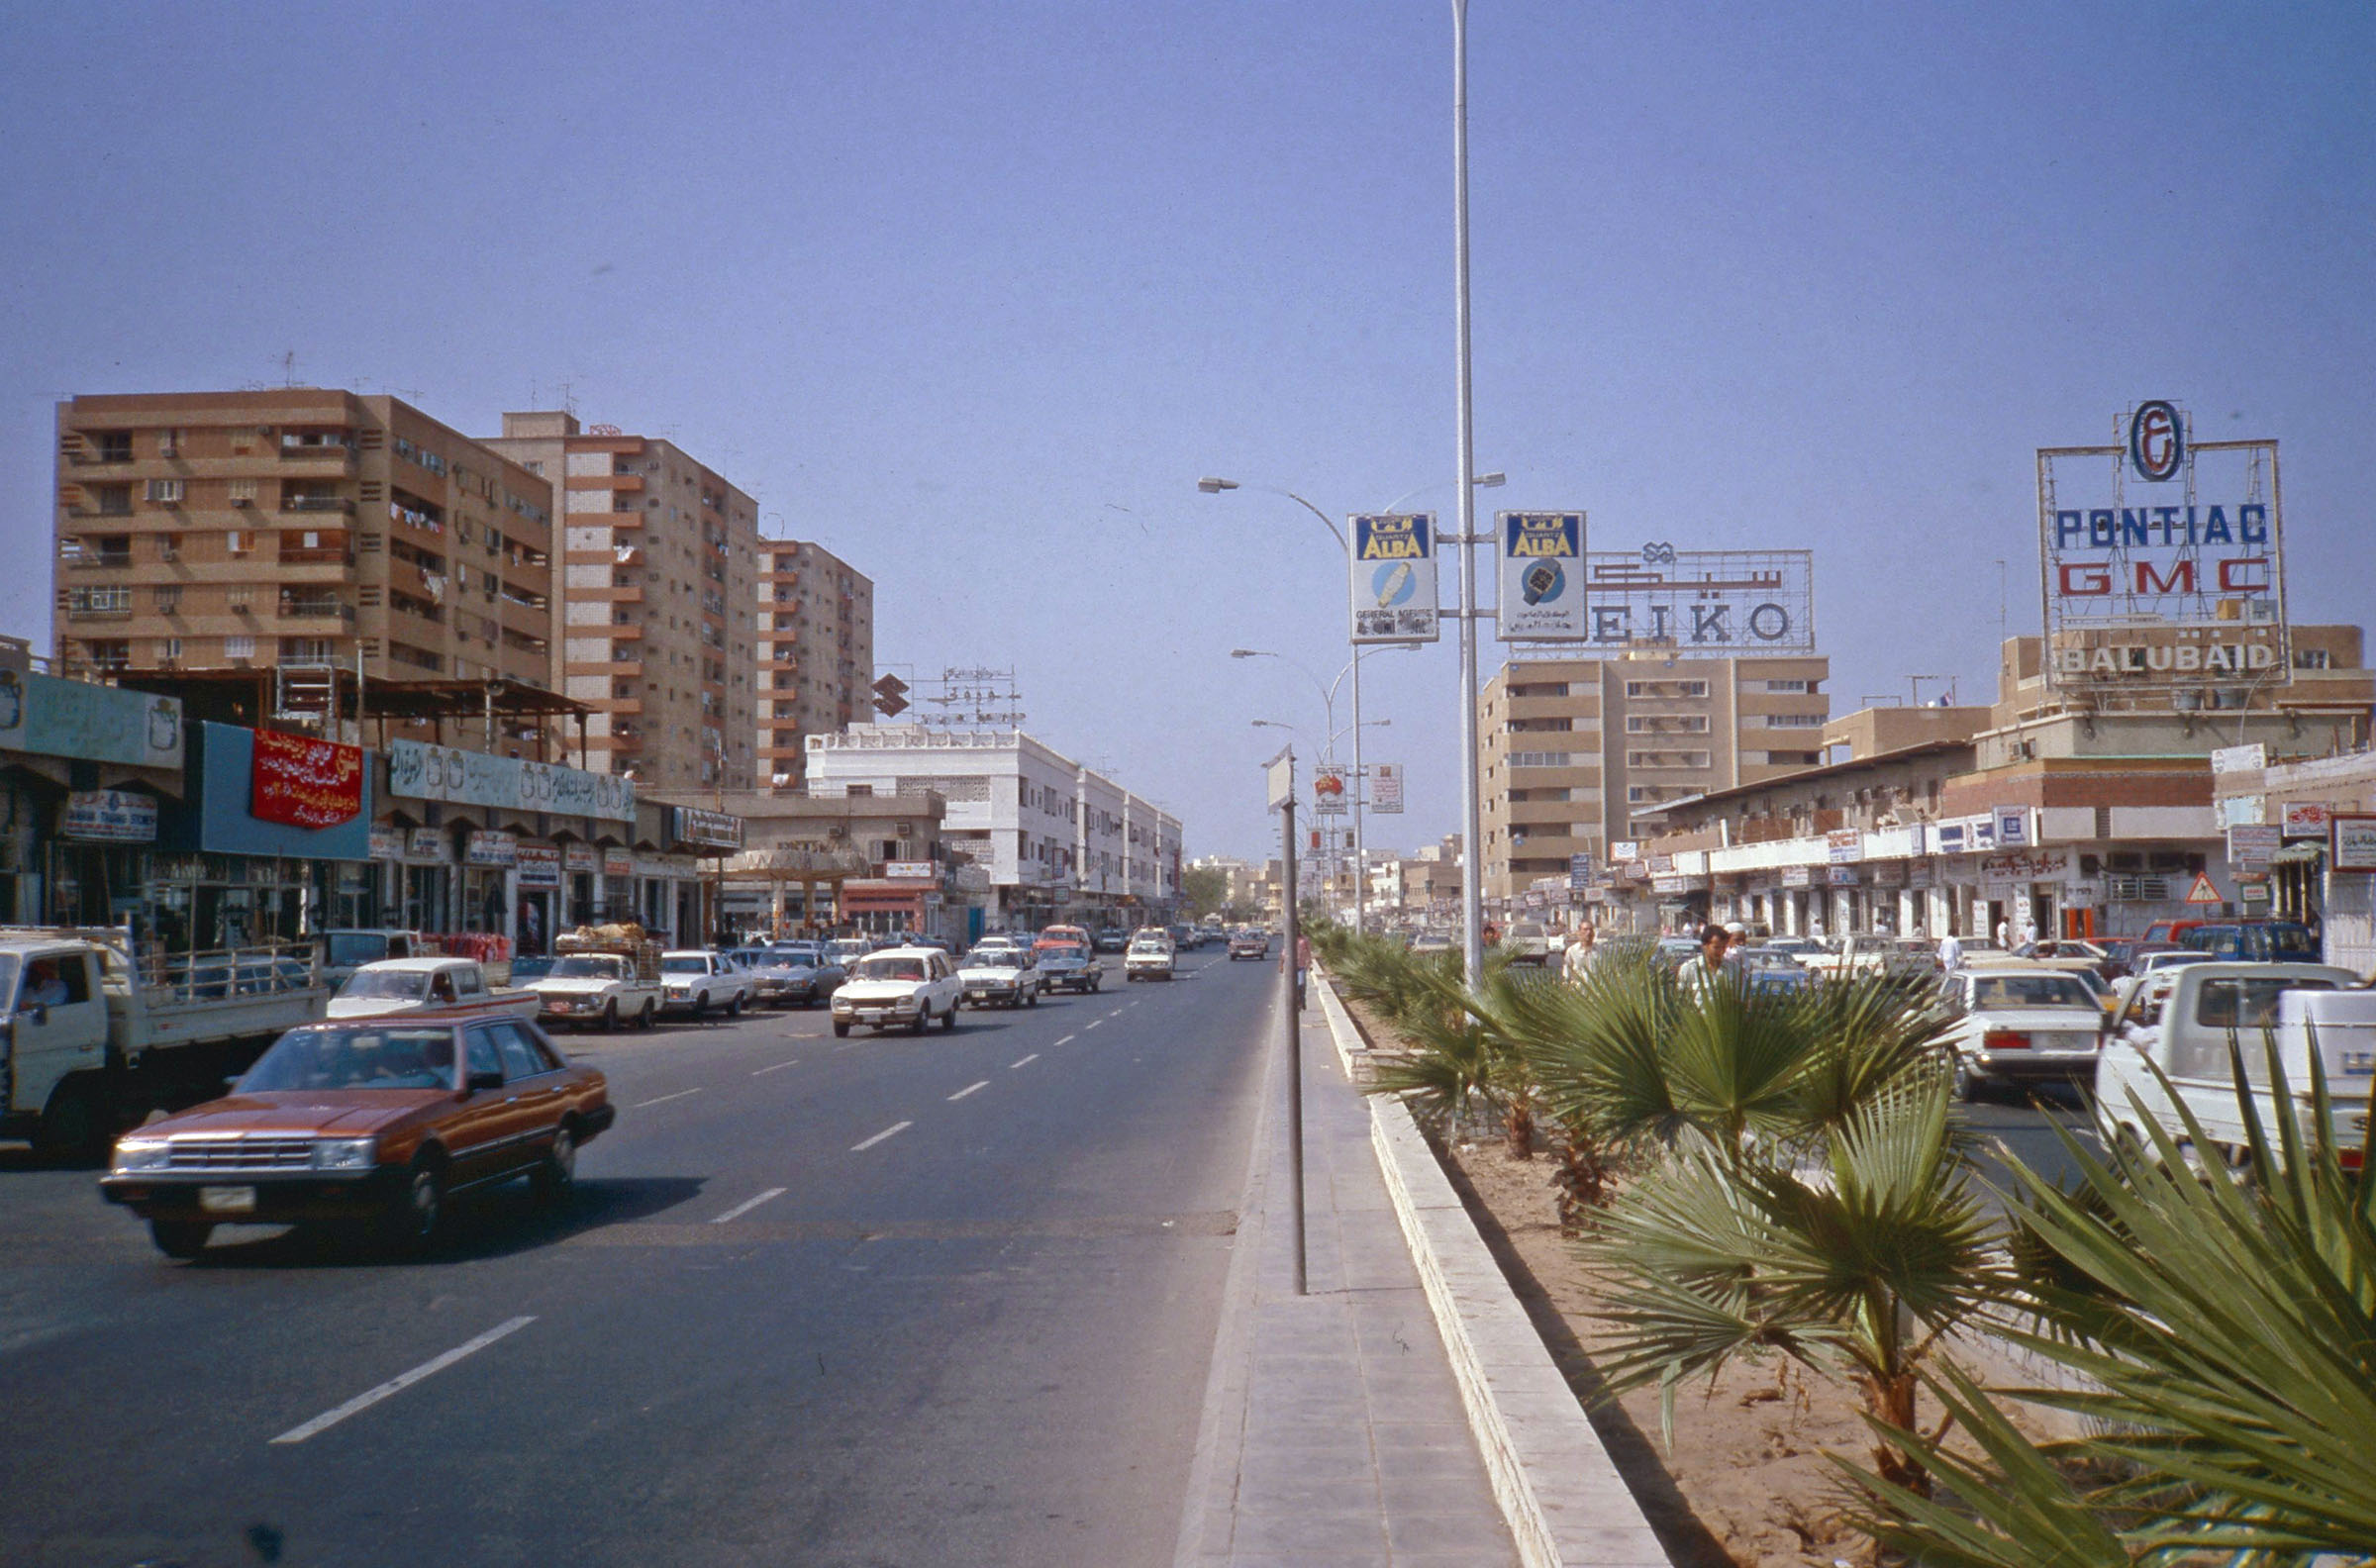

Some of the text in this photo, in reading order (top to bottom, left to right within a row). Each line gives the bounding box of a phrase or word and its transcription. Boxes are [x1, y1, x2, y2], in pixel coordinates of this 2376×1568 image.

[2057, 503, 2268, 548] PONTIAC
[1363, 534, 1424, 559] ALBA
[1513, 532, 1574, 556] ALBA
[1586, 563, 1782, 599] سيك
[2059, 558, 2270, 595] GMC
[1356, 610, 1395, 619] GENERAL
[1592, 604, 1789, 641] EIKO
[2063, 644, 2273, 672] BALUBAID
